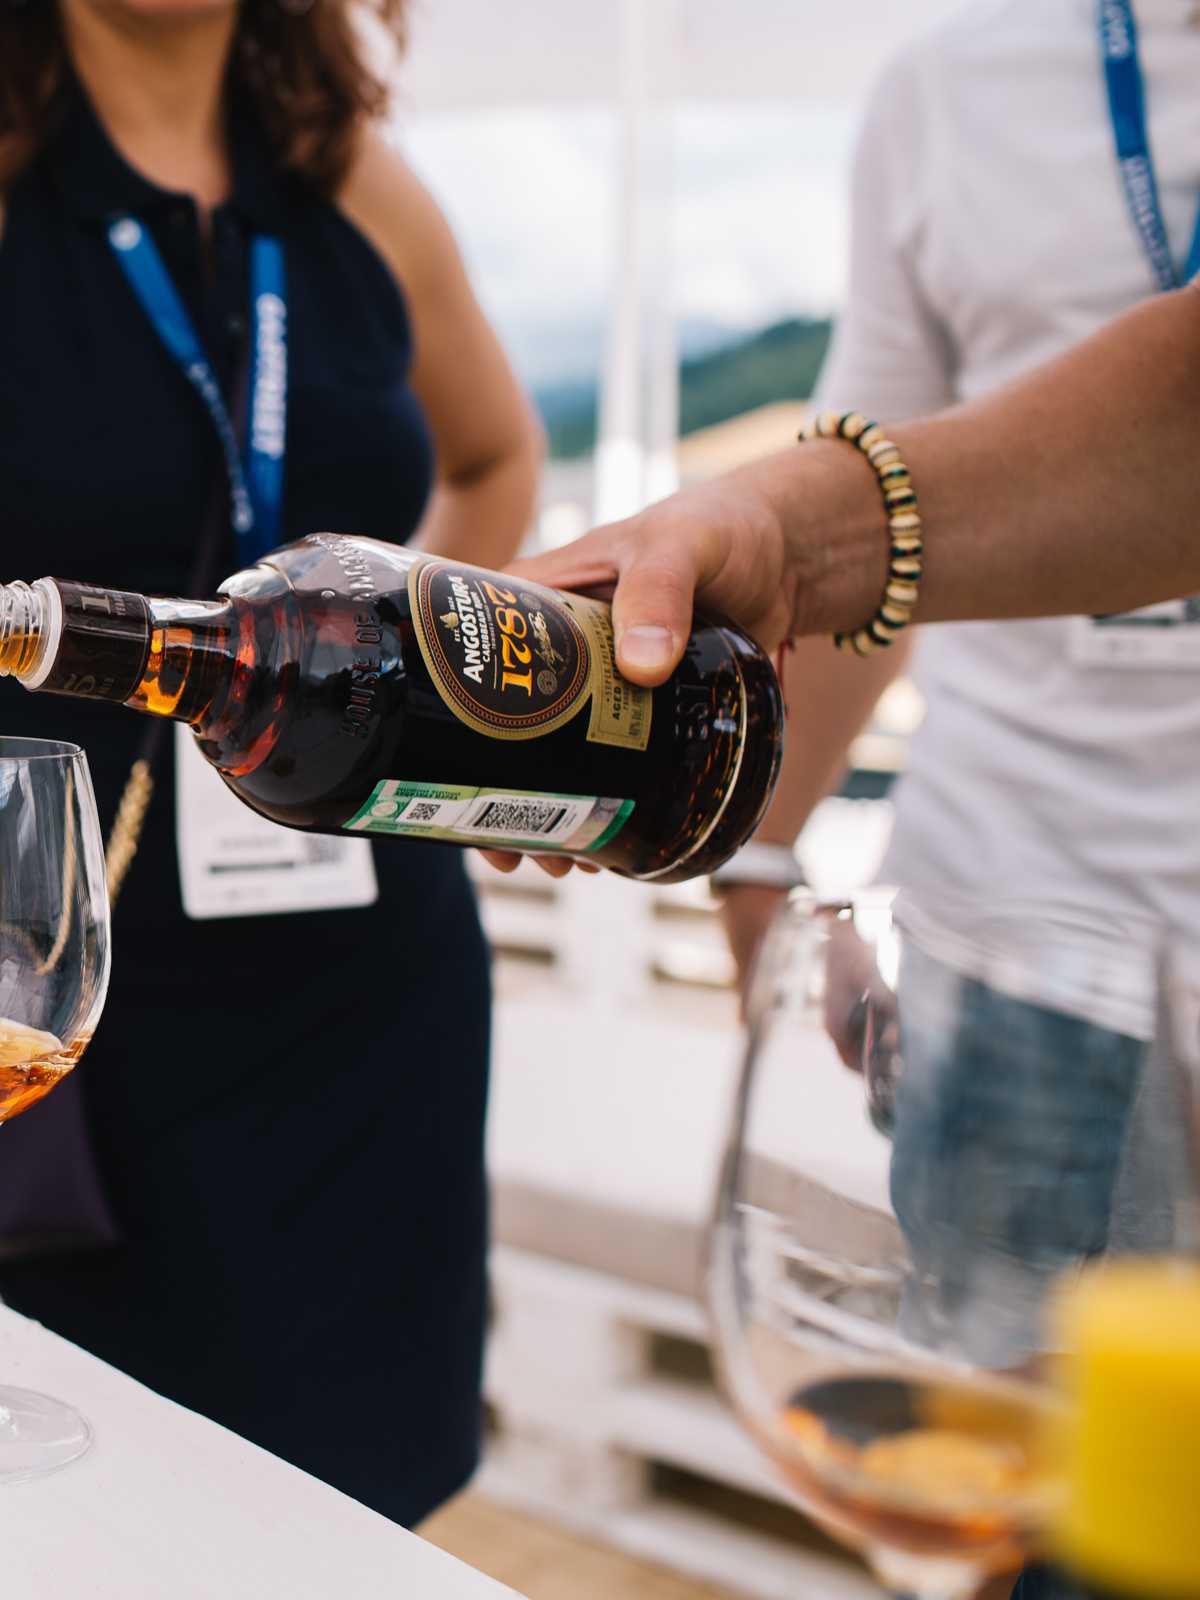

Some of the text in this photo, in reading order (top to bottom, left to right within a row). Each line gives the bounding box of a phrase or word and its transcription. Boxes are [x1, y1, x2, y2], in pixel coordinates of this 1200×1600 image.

[355, 614, 384, 646] OF
[448, 575, 484, 684] ANGOSTURA
[470, 591, 491, 662] CARIBBEAN RUM
[481, 581, 533, 697] 1787
[340, 655, 383, 739] HOUSE
[604, 669, 612, 695] SUPER
[612, 687, 621, 720] AGED
